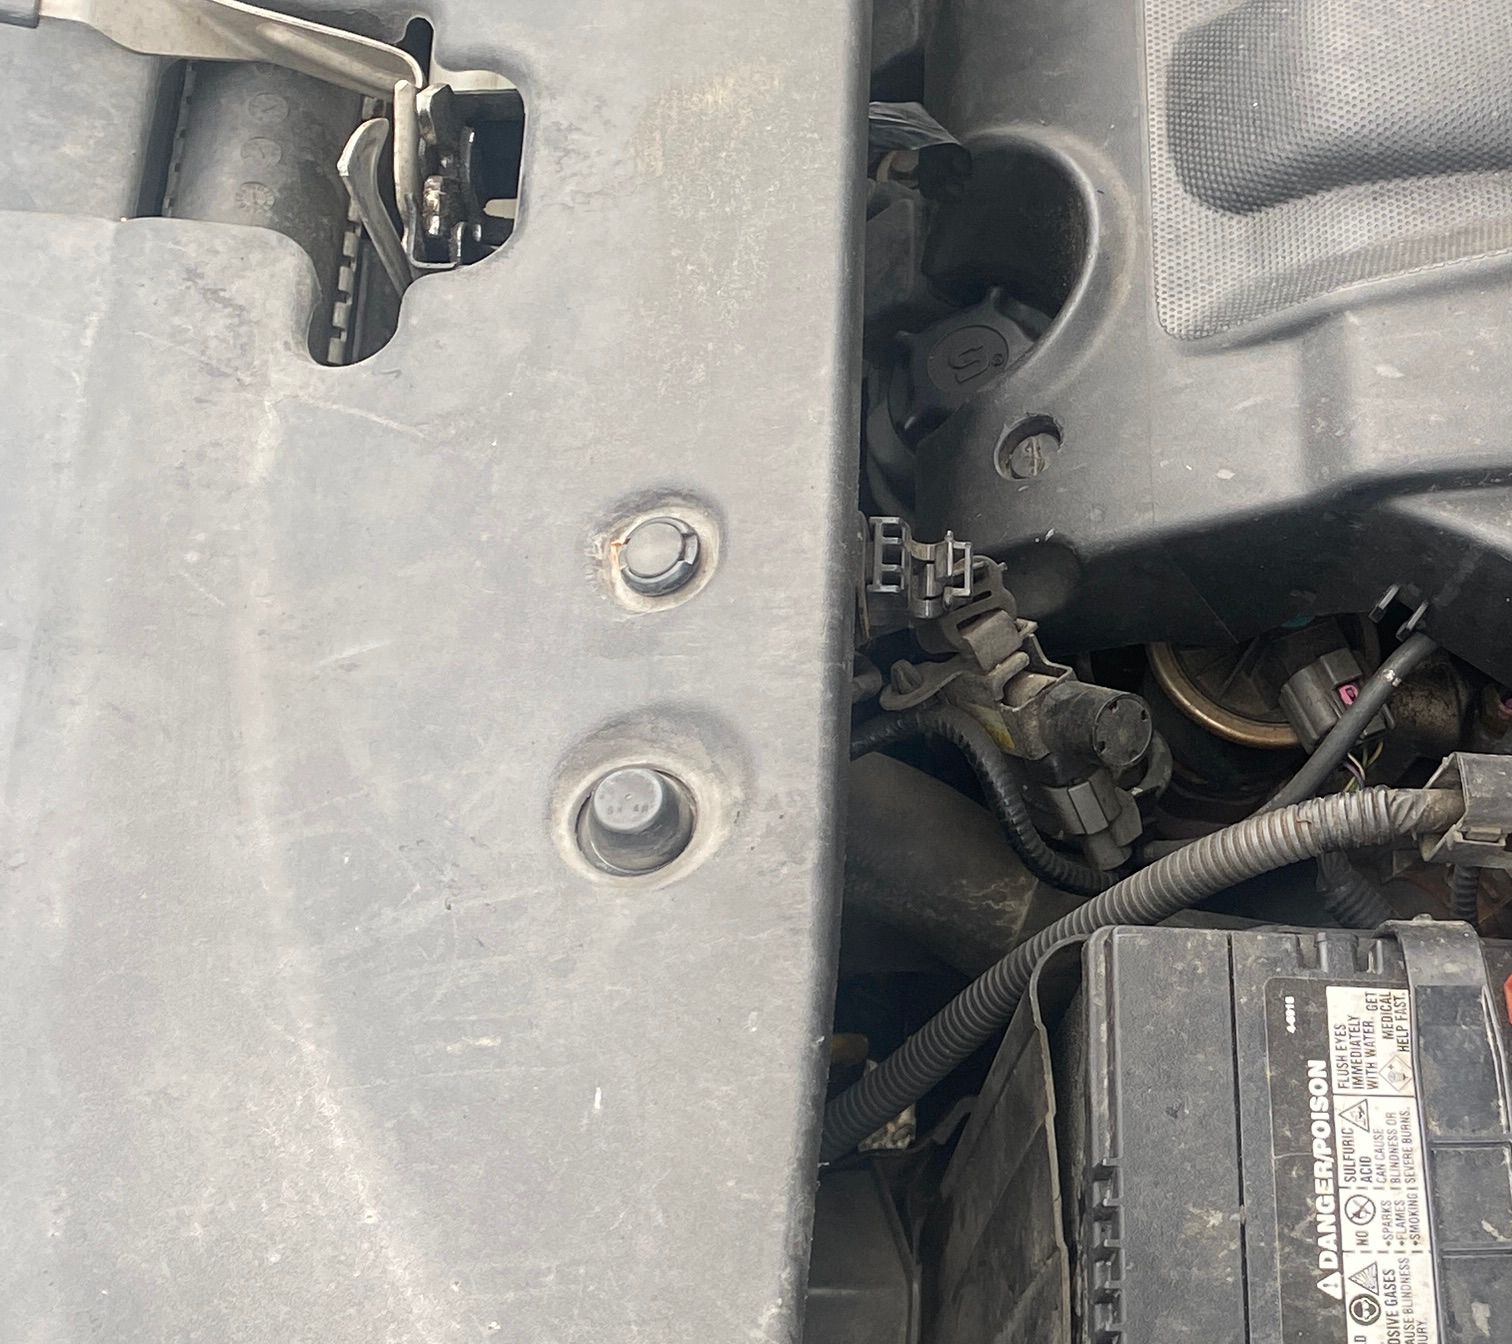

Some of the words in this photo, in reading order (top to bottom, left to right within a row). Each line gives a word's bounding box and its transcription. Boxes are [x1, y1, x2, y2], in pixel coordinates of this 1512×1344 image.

[1365, 992, 1378, 1011] GET
[1380, 992, 1394, 1040] MEDICAL
[1393, 992, 1408, 1025] FAST.
[1334, 1024, 1348, 1052] EYES
[1347, 1015, 1365, 1090] IMMEDIATELY
[1396, 1026, 1410, 1052] HELP
[1336, 1054, 1350, 1090] FLUSH
[1365, 1059, 1379, 1090] WITH
[1385, 1111, 1397, 1123] OR
[1399, 1106, 1413, 1143] BURNS.
[1340, 1127, 1357, 1182] SULFURIC
[1373, 1128, 1386, 1158] CAUSE
[1386, 1125, 1401, 1183] BLINDNESS
[1307, 1059, 1339, 1269] DANGER/POISON
[1358, 1155, 1373, 1183] ACID
[1375, 1161, 1388, 1183] CAN
[1401, 1146, 1416, 1183] SEVERE
[1380, 1200, 1394, 1241] SPARKS
[1394, 1199, 1408, 1241] FLAMES
[1406, 1191, 1421, 1240] SMOKING
[1355, 1230, 1370, 1246] NO
[1382, 1268, 1399, 1306] GASES
[1398, 1257, 1415, 1315] BLINDNESS
